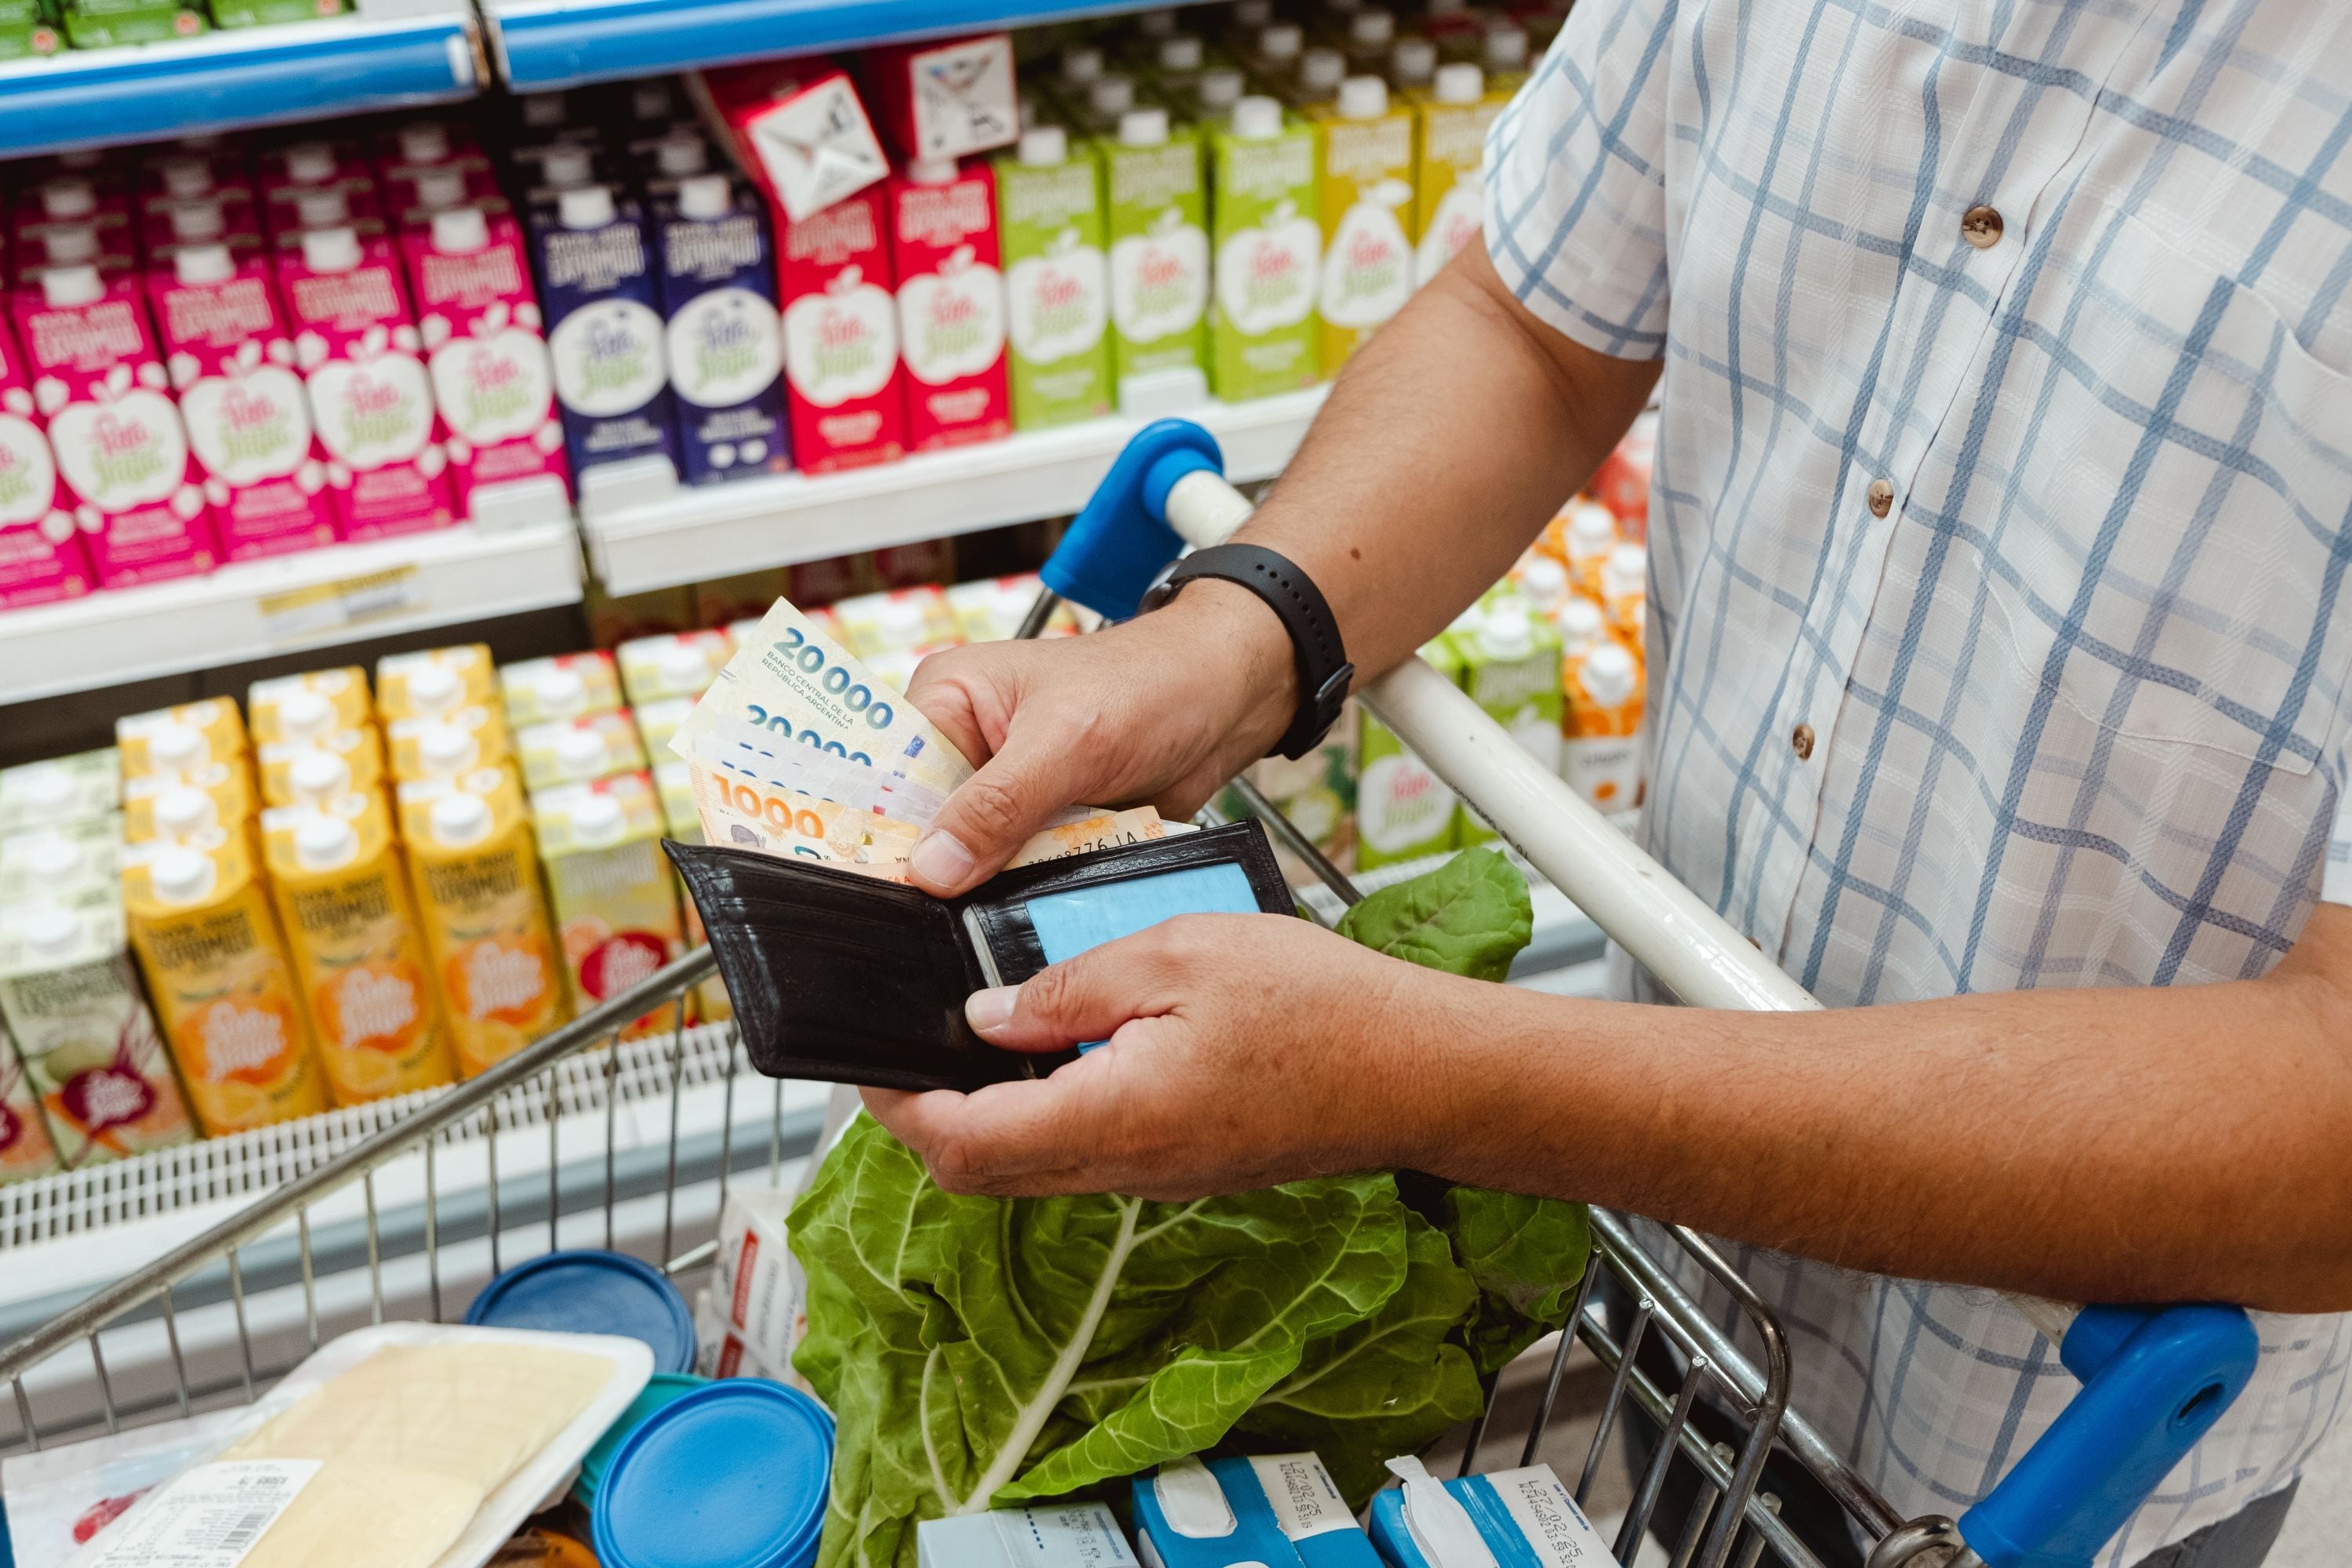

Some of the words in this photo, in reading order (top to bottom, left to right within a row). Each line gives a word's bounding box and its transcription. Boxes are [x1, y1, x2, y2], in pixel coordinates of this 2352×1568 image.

[761, 659, 804, 696] REPÚBLICA
[767, 652, 796, 677] BANCO
[796, 676, 829, 706] CENTRAL
[830, 704, 844, 717] DE
[844, 713, 854, 725] LA
[712, 772, 826, 840] 1000
[1528, 1480, 1583, 1557] L27/02/25
